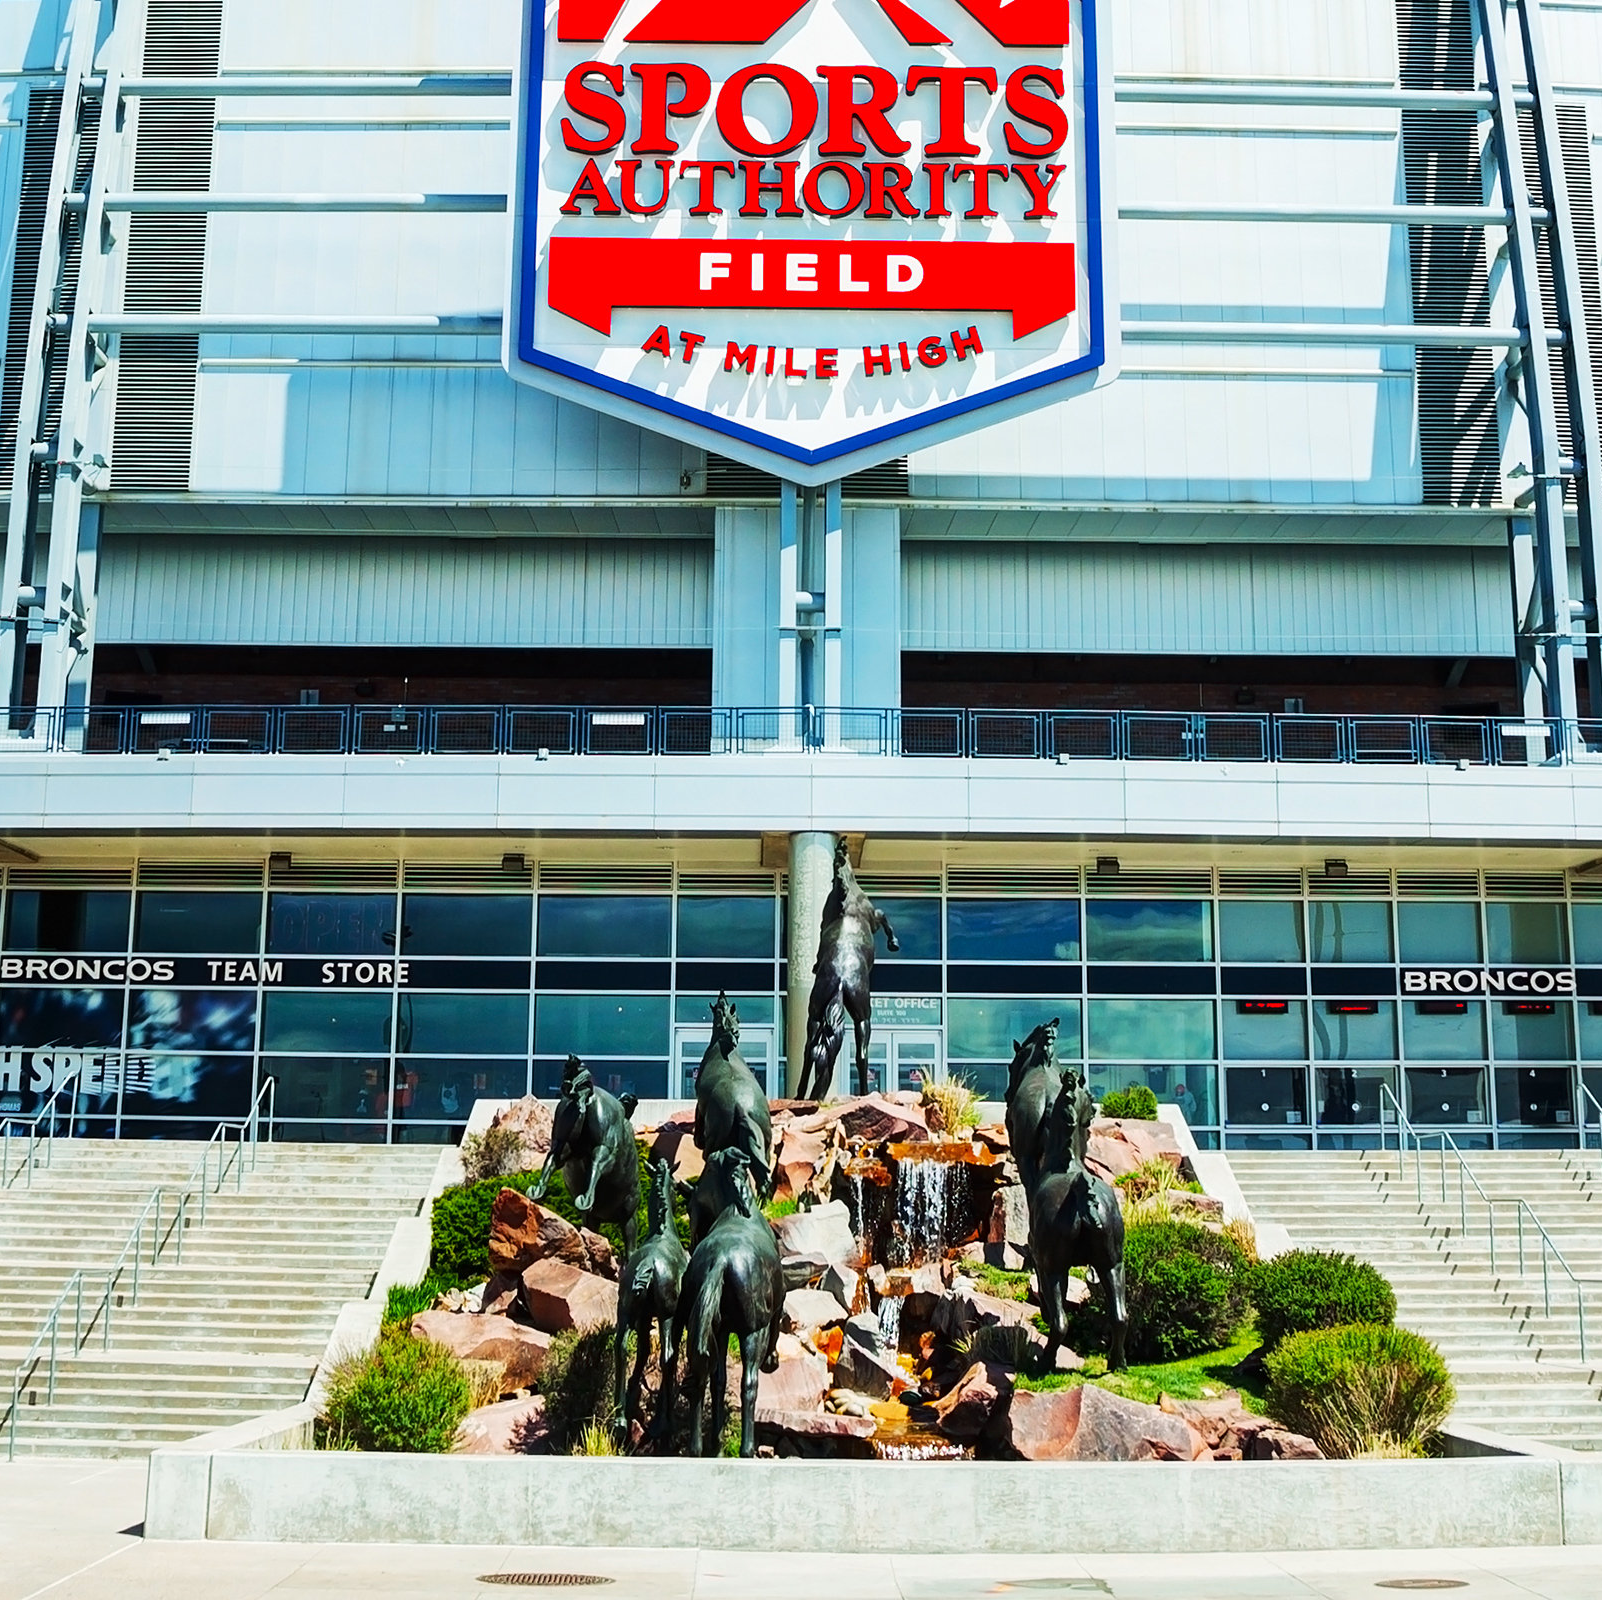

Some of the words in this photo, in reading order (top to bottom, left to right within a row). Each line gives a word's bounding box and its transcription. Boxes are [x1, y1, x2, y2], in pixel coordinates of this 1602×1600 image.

[560, 60, 1069, 159] SPORTS
[559, 158, 1067, 220] AUTHORITY
[699, 252, 924, 293] FIELD
[640, 325, 706, 364] AT
[724, 341, 839, 378] MILE
[863, 326, 984, 376] HIGH
[0, 958, 175, 981] BRONCOS
[207, 960, 284, 983] TEAM
[321, 962, 410, 984] STORE
[1403, 969, 1578, 993] BRONCOS
[894, 998, 937, 1009] OFFICE
[29, 1045, 158, 1094] SPEED
[1351, 1069, 1358, 1078] 2
[1441, 1069, 1447, 1078] 3
[1529, 1069, 1536, 1078] 4
